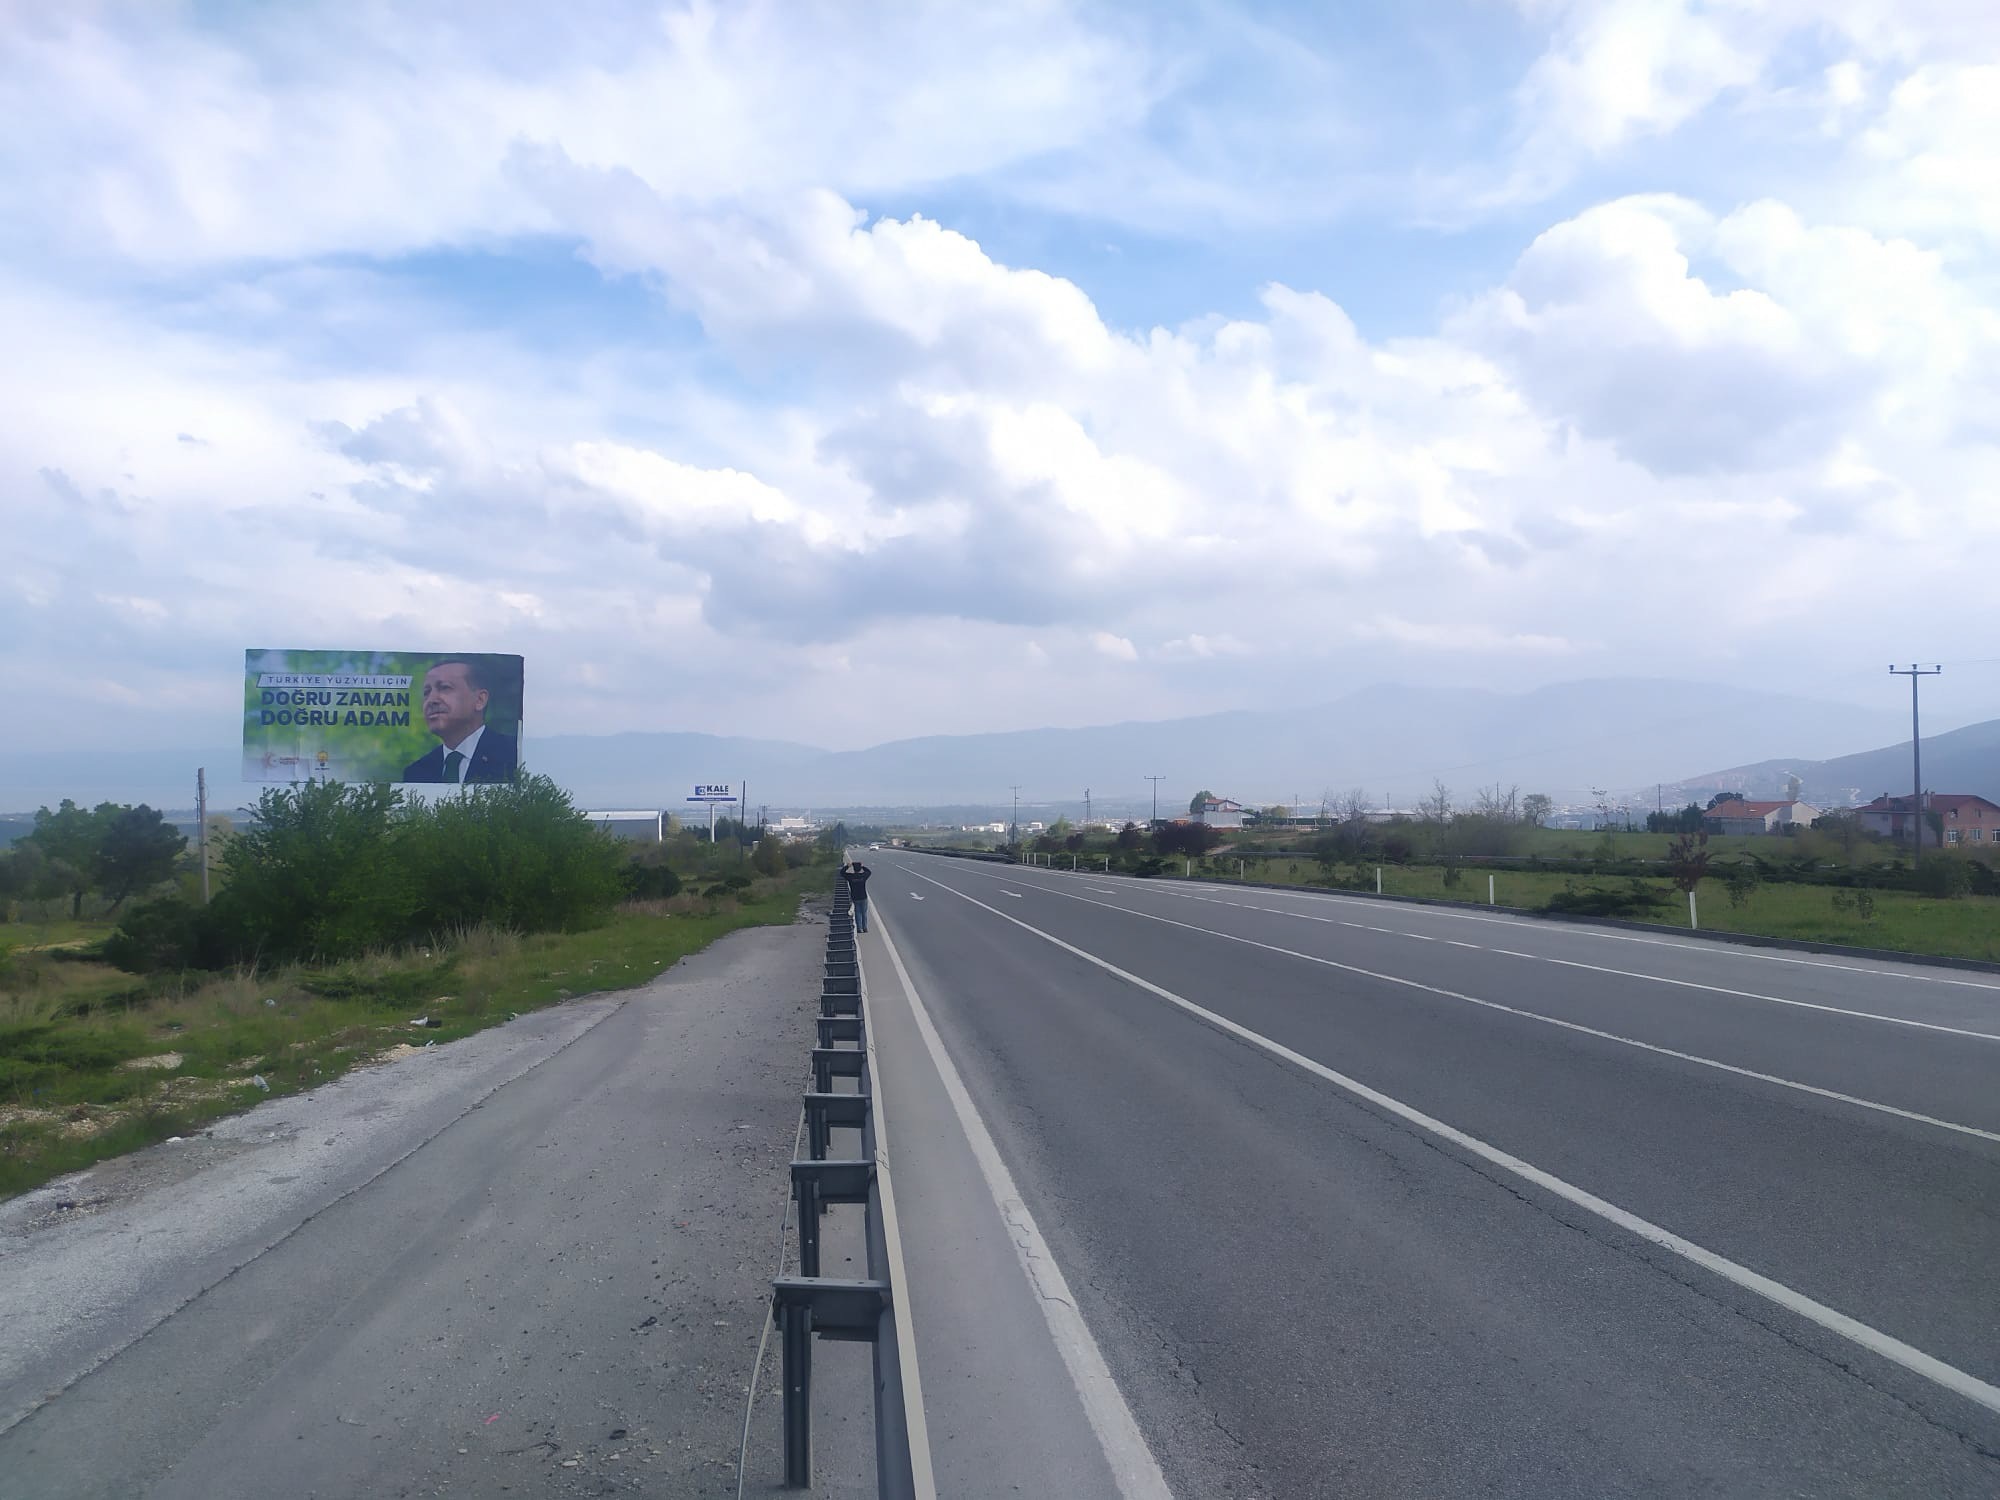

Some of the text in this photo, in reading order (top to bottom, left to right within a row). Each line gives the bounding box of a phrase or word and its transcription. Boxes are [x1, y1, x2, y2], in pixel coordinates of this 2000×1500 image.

[261, 689, 410, 707] DOĞRU ZAMAN
[260, 708, 410, 727] DOĞRU ADAM
